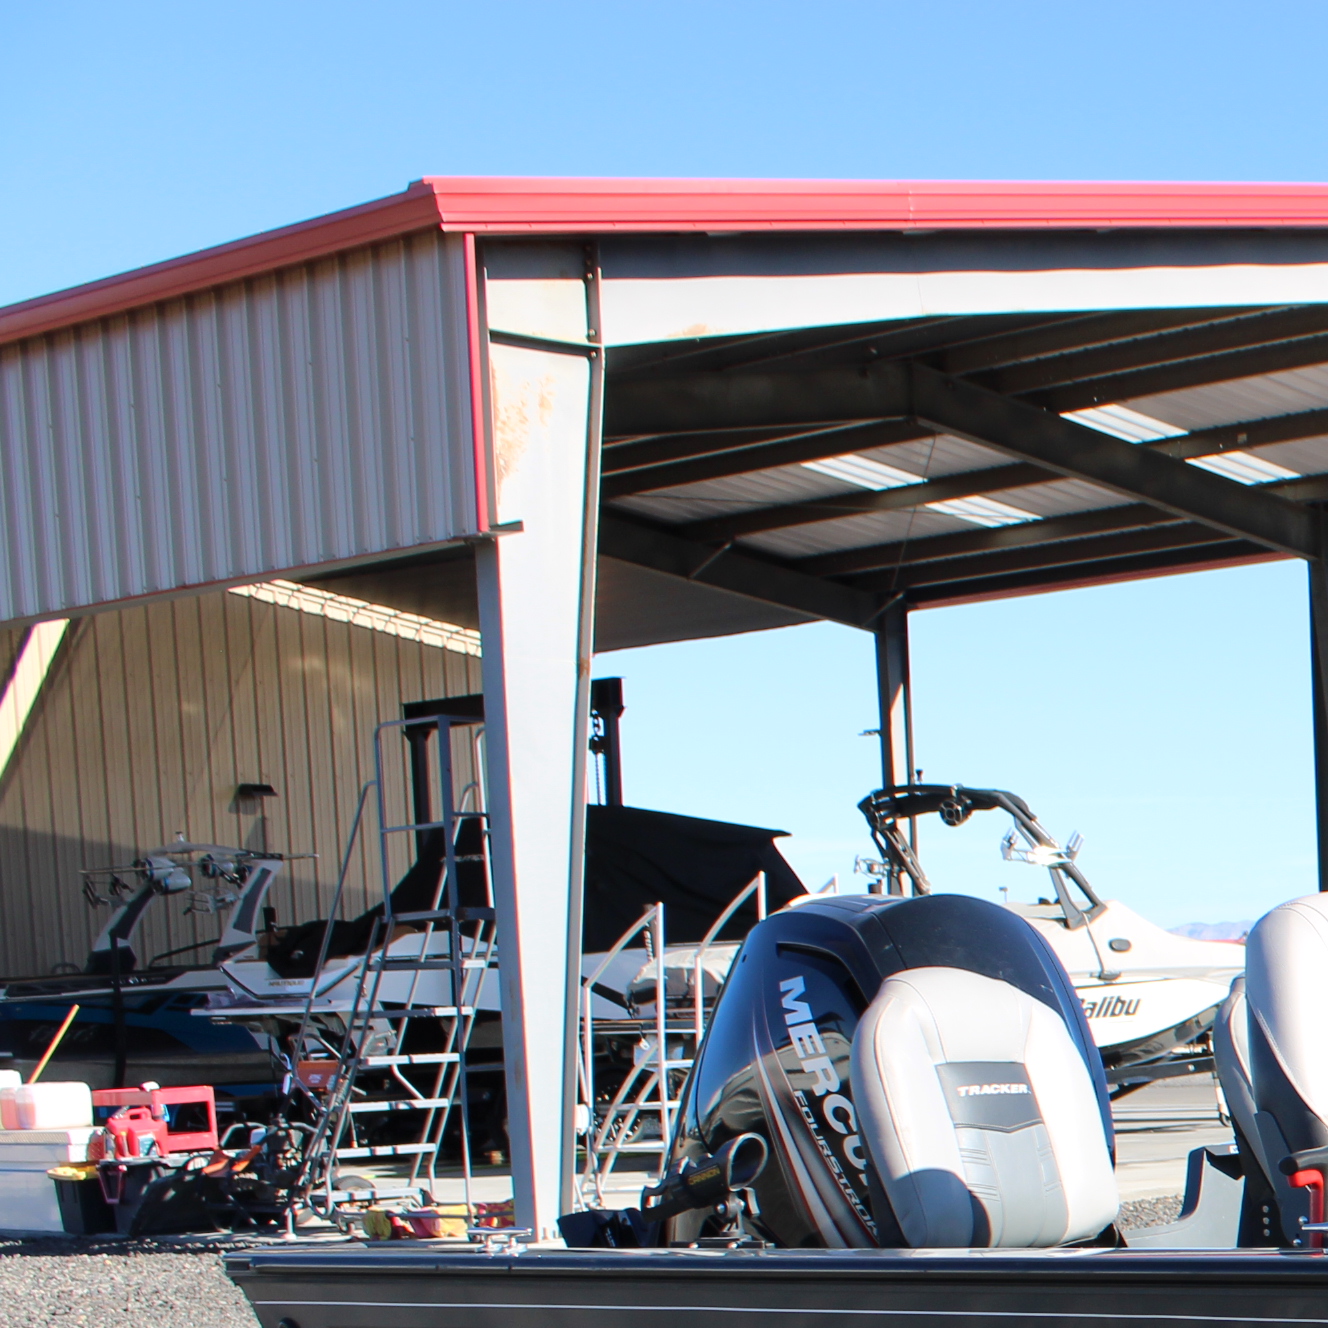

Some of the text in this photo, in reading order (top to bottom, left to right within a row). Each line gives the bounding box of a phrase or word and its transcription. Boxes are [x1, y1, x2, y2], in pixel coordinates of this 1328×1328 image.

[1081, 996, 1141, 1018] alibu
[779, 976, 869, 1187] MERCU
[957, 1083, 1029, 1097] TRACKER
[795, 1090, 878, 1237] FOURSTROK
